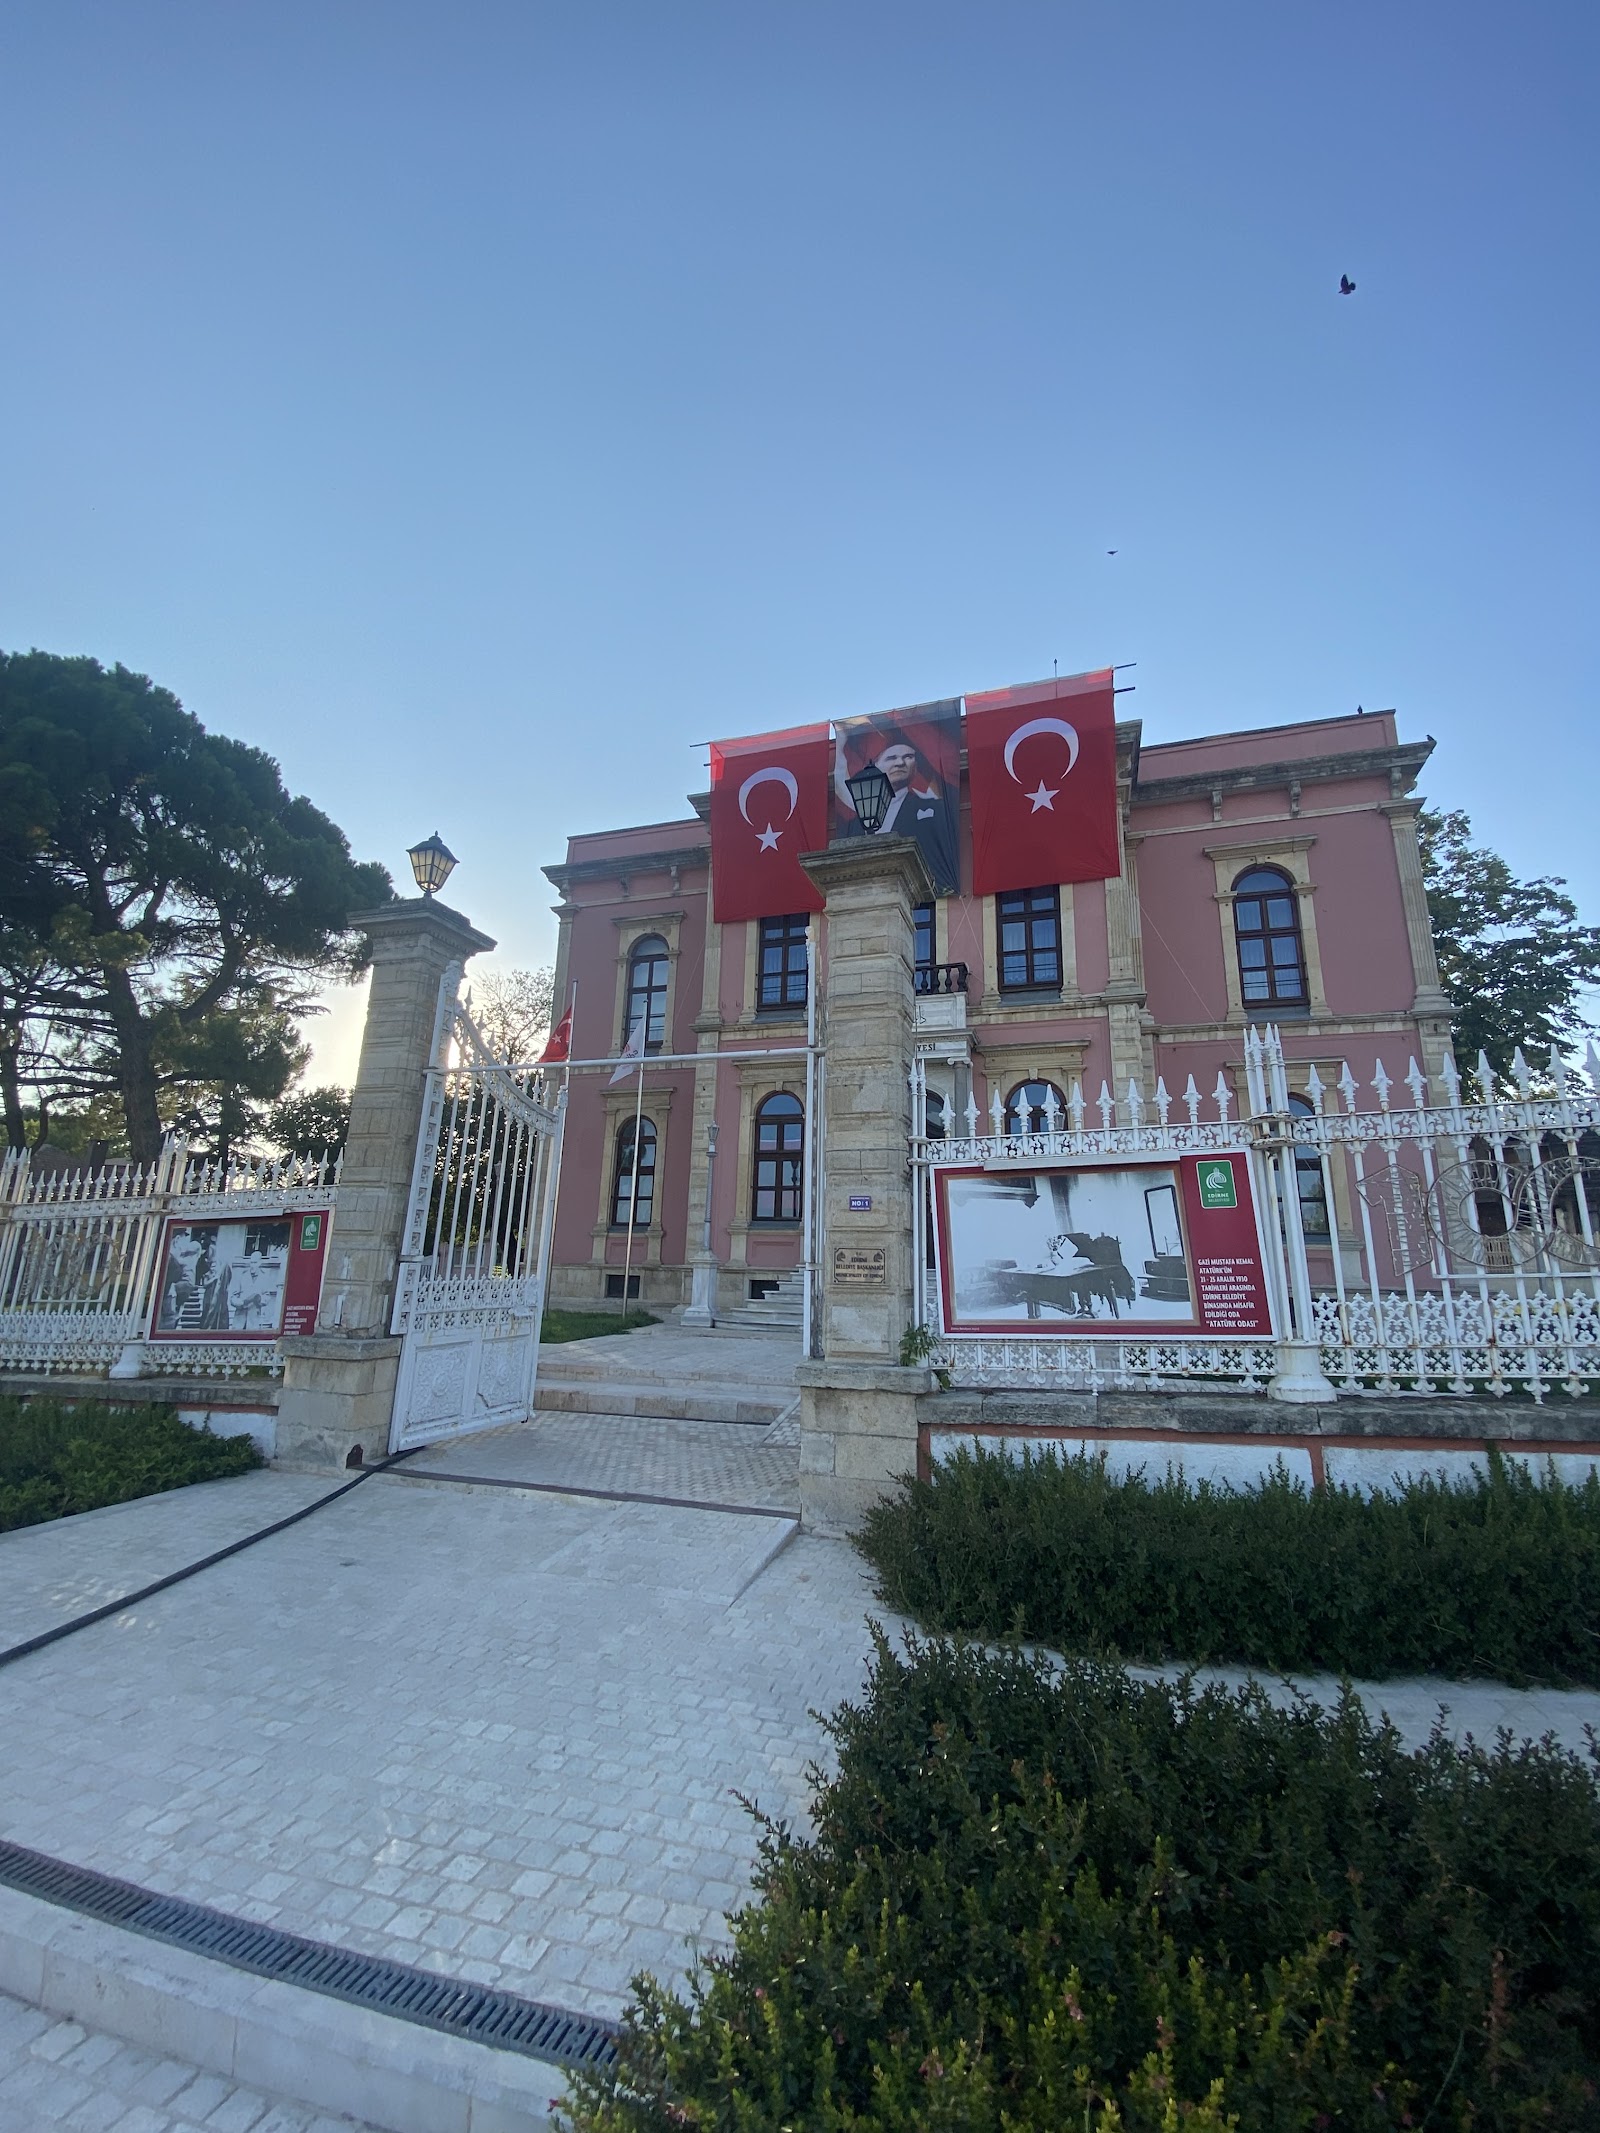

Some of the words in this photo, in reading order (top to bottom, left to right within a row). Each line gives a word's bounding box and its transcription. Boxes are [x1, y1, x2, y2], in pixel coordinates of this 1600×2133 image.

[1198, 1258, 1210, 1266] GAZİ
[1199, 1266, 1233, 1274] ATATÜRK'ÜN
[1202, 1292, 1221, 1300] EDİRNE
[1221, 1292, 1246, 1300] BELEDİYE
[1203, 1301, 1232, 1309] BİNASINDA
[1233, 1301, 1255, 1309] MİSAFİR
[1204, 1310, 1227, 1318] EDİLDİĞİ
